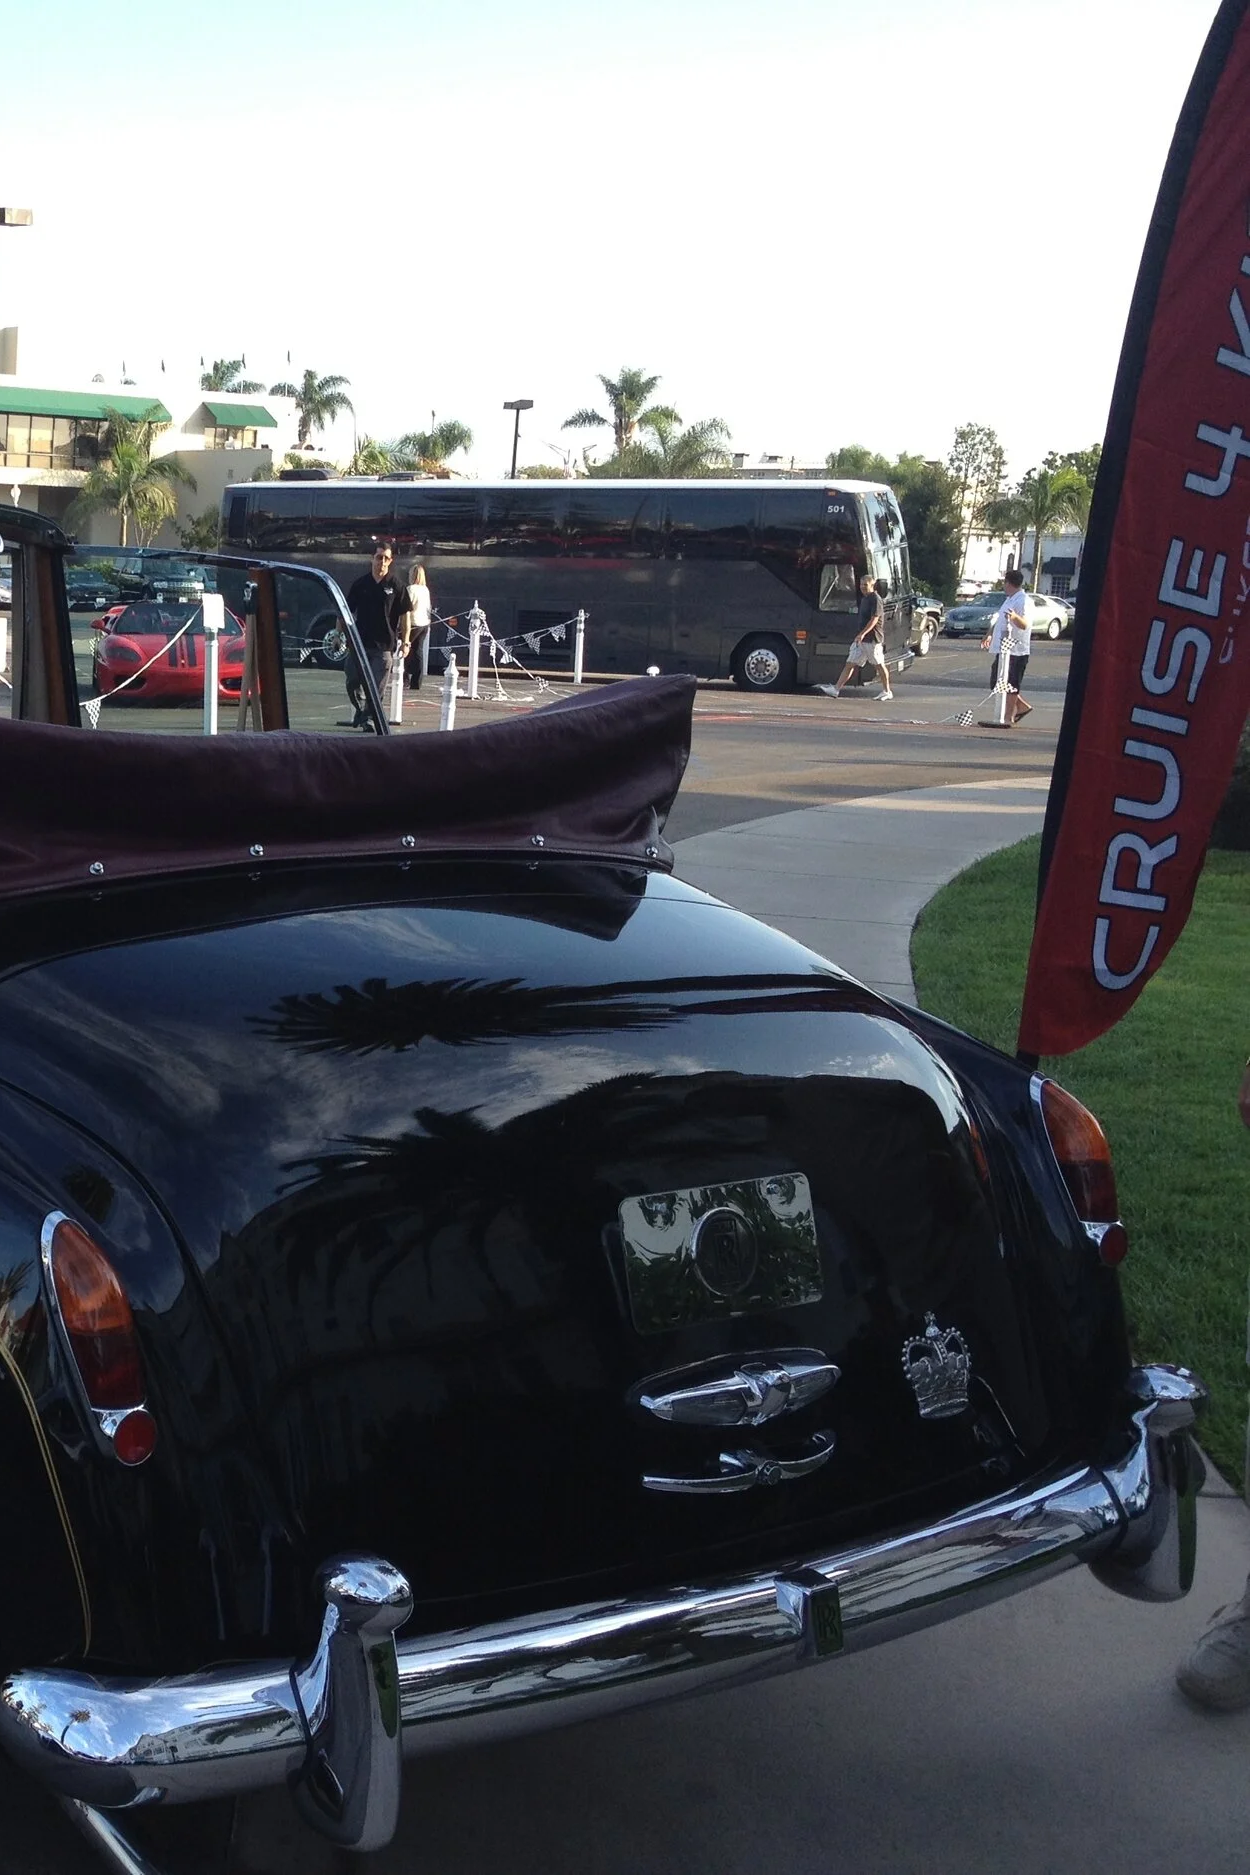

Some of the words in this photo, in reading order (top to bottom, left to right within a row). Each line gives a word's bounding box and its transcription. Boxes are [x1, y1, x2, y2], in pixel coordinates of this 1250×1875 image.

[827, 505, 845, 513] 501
[1091, 538, 1227, 991] CRUISE
[1184, 421, 1250, 498] 4
